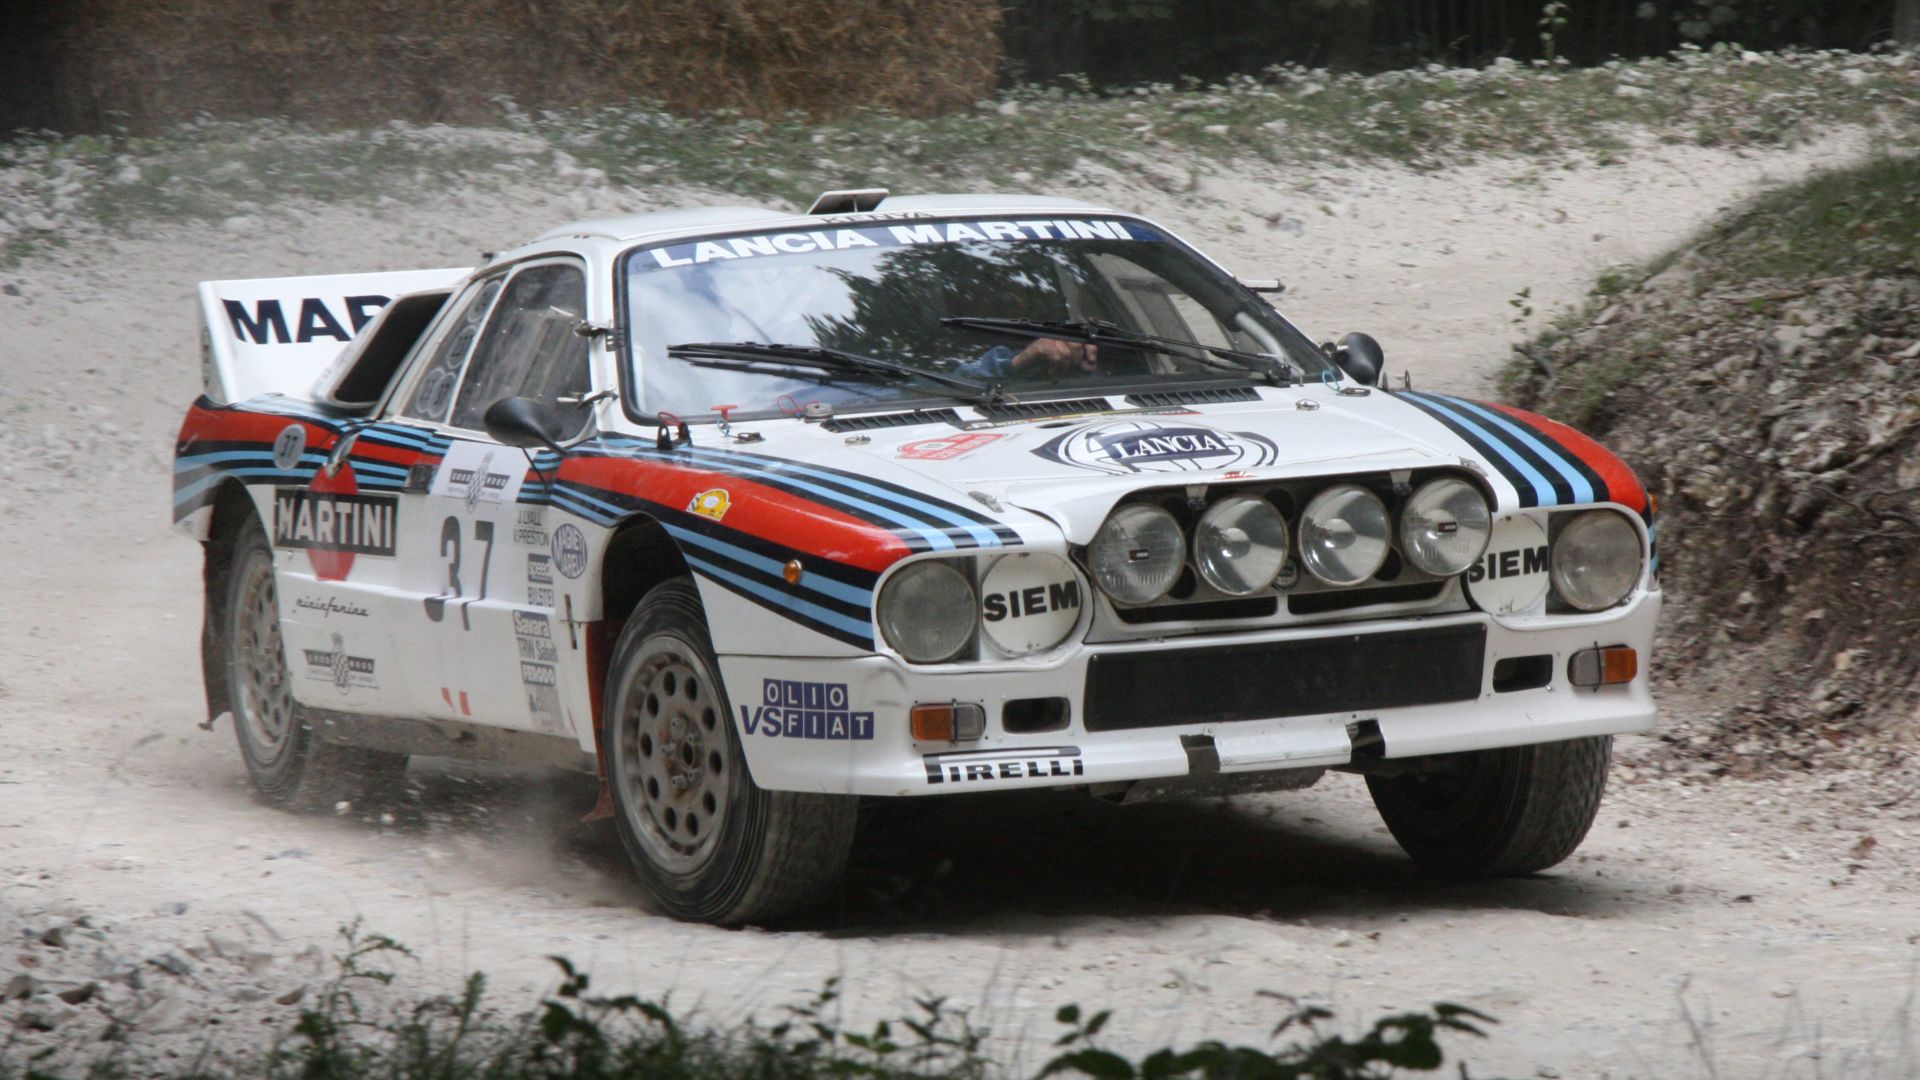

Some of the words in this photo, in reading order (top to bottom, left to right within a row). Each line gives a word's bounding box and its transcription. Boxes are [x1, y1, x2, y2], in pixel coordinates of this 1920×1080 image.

[650, 228, 879, 268] LANCIA
[888, 220, 1134, 245] MARTINI
[1112, 434, 1226, 459] LANCIA
[278, 497, 392, 549] MARTINI
[423, 515, 495, 631] 37
[1470, 545, 1549, 583] SIEM
[983, 580, 1079, 622] SIEM
[765, 682, 845, 707] OLIO
[740, 704, 782, 738] VS
[786, 712, 870, 737] FIAT
[922, 746, 1083, 784] PIRELLI
